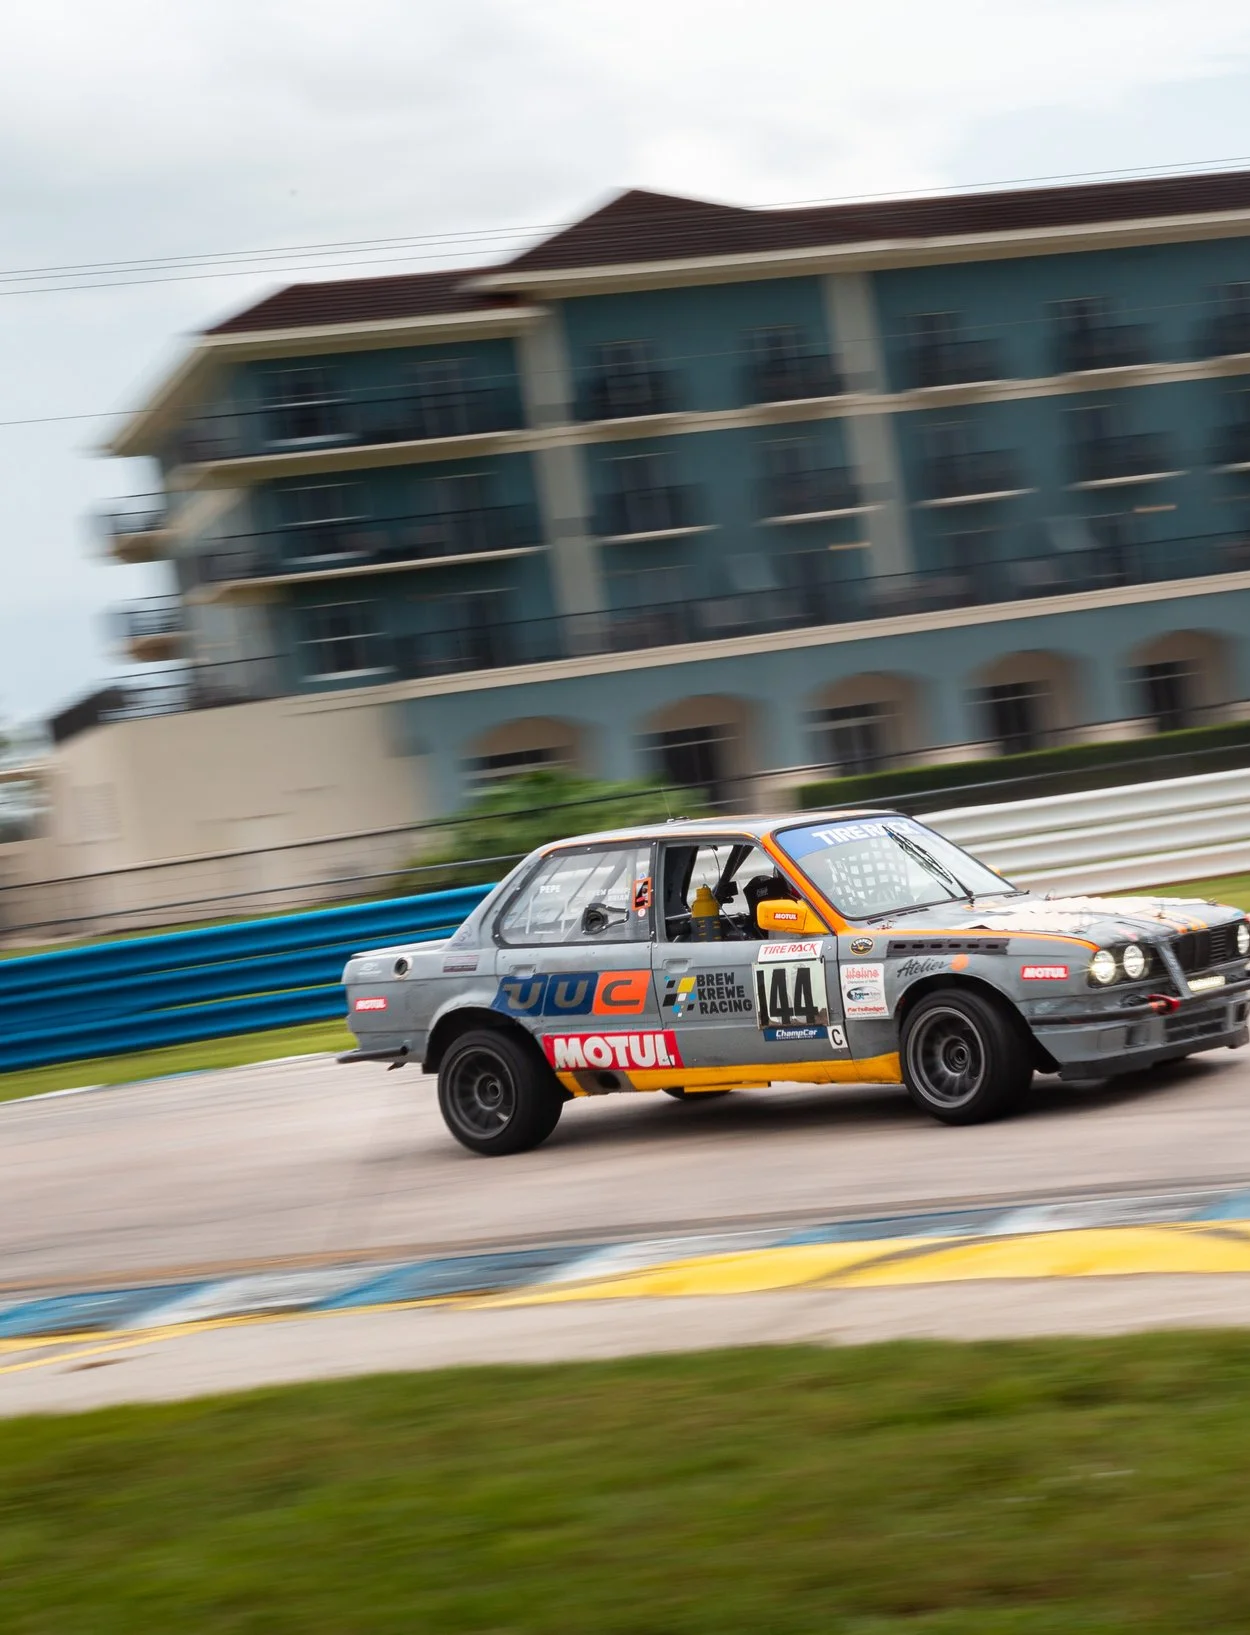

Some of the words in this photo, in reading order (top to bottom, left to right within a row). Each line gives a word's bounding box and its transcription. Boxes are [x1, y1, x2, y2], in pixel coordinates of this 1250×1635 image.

[811, 824, 867, 846] TIRE
[540, 884, 561, 893] PEPE
[774, 912, 798, 920] MOTUL
[763, 945, 788, 955] TIRE
[787, 943, 818, 956] RACK
[897, 957, 945, 978] Atelier
[1023, 967, 1068, 979] MOTUL
[696, 972, 735, 987] BREW
[698, 985, 745, 1001] KREWE
[756, 967, 819, 1027] 144
[699, 999, 752, 1015] RACING
[775, 1029, 818, 1039] ChampCar
[831, 1028, 843, 1046] C
[553, 1033, 676, 1069] MOTUL
